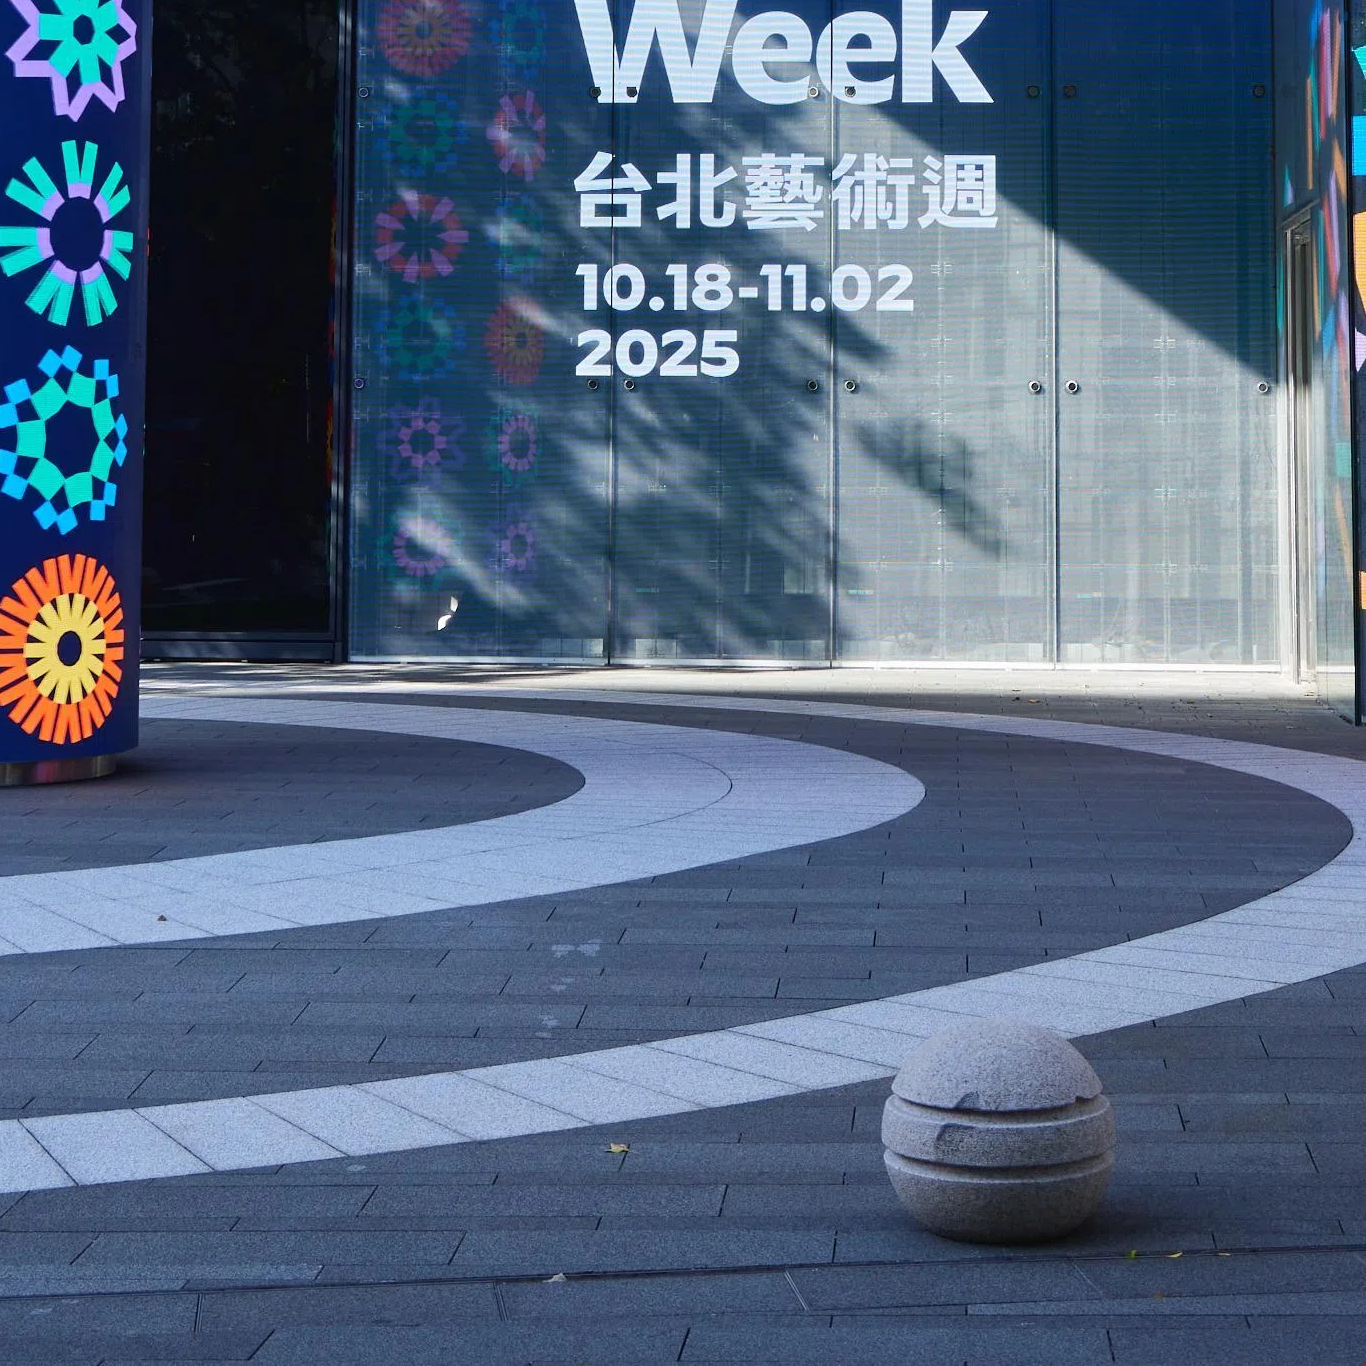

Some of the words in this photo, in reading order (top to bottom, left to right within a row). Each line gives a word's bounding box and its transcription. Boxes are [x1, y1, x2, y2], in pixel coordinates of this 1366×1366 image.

[574, 151, 998, 231] 台北藝術週
[575, 263, 914, 312] 10.18-11.02
[575, 329, 740, 377] 2025
